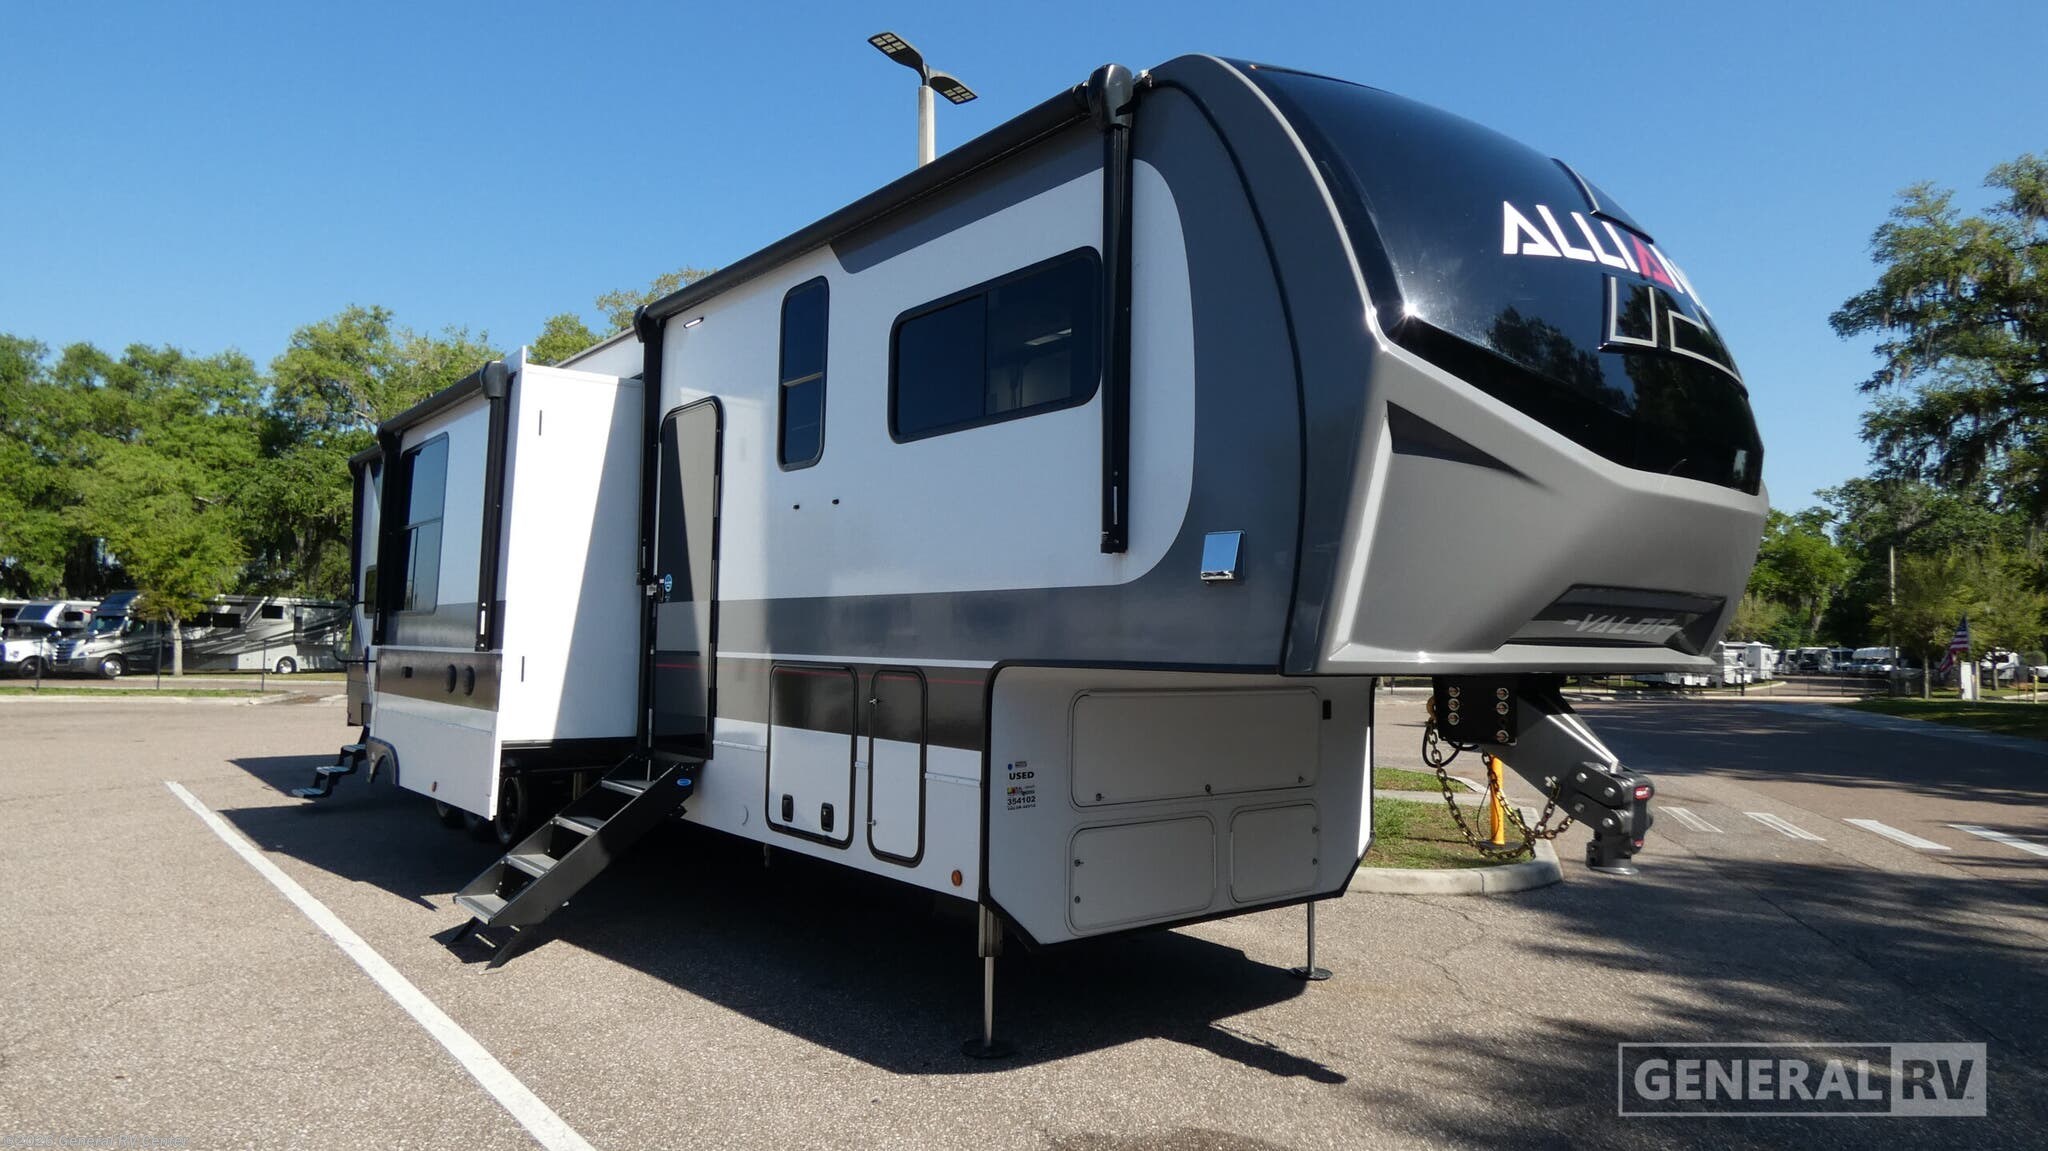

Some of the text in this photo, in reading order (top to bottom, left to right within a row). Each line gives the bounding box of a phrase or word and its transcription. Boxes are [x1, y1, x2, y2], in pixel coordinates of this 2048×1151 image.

[1576, 613, 1675, 635] VALOR
[1008, 771, 1035, 780] USED
[1007, 796, 1036, 806] 354102
